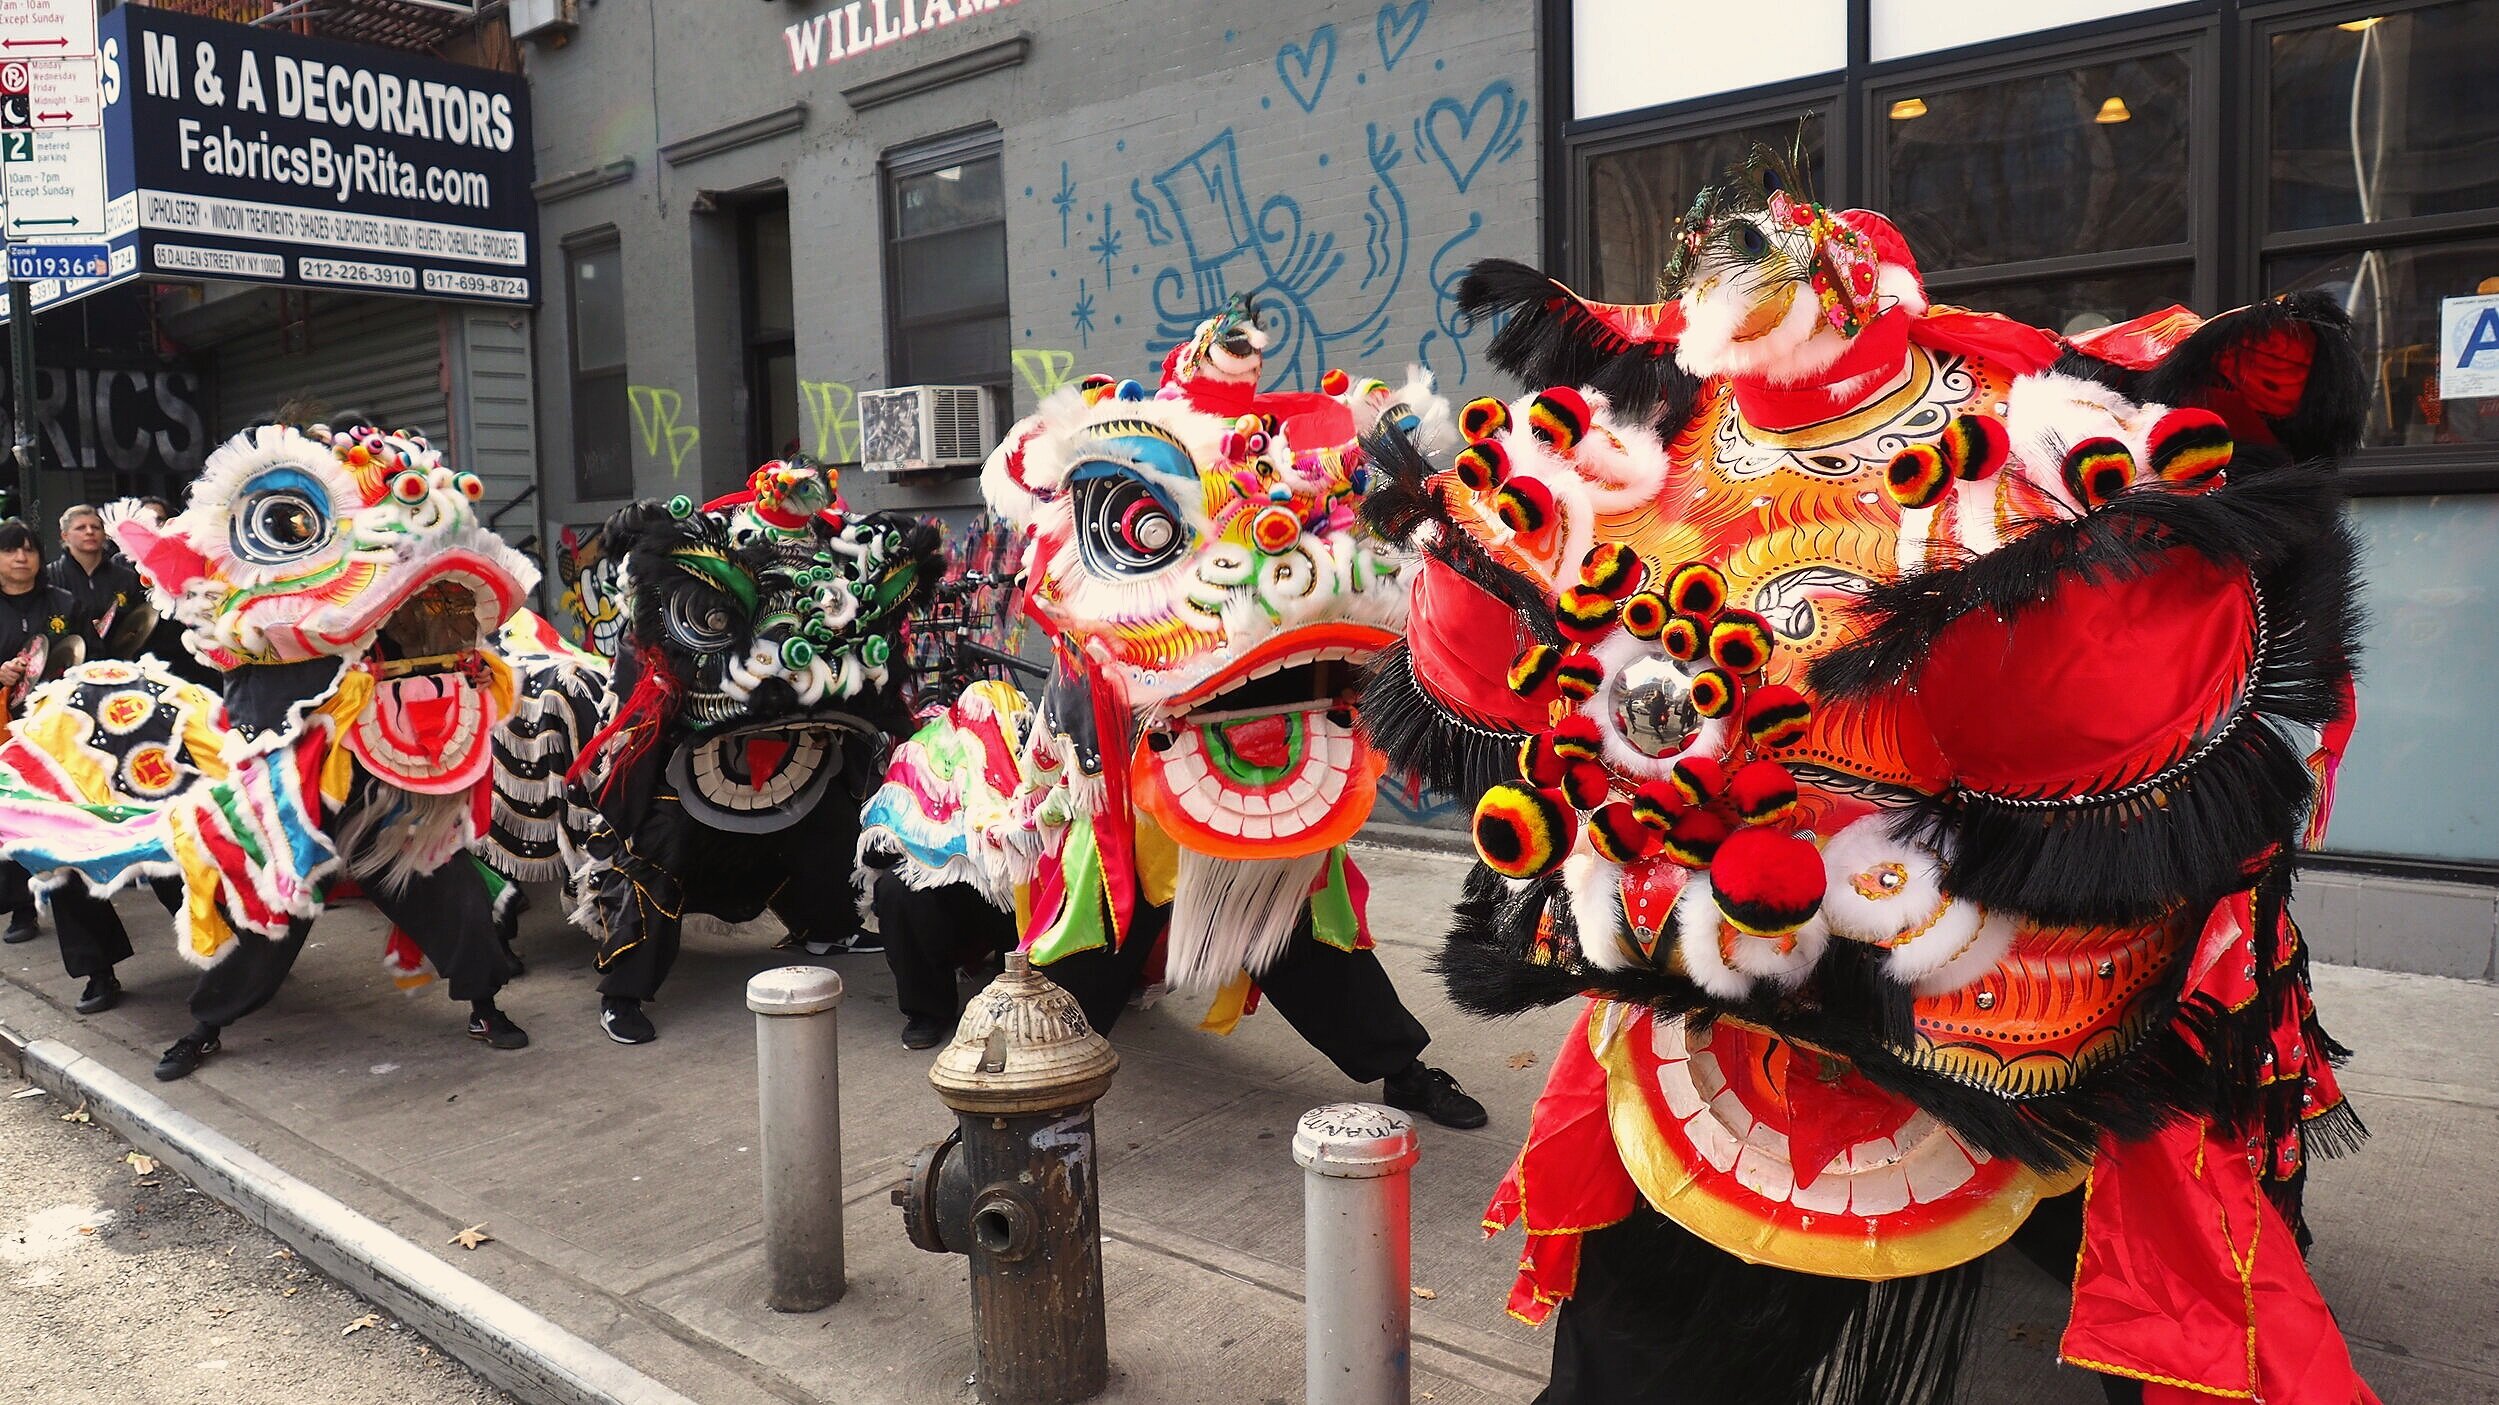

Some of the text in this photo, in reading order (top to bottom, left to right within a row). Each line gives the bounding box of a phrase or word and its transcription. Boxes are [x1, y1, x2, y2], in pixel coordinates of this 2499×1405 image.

[32, 13, 65, 25] Sunday
[784, 0, 1000, 75] WILLIA
[142, 30, 514, 153] M & A DECORATORS
[9, 132, 27, 160] 2
[178, 117, 490, 209] FabricsByRita.com
[9, 173, 32, 184] 10am
[41, 172, 60, 183] 7pm
[9, 186, 75, 198] Except Sunday
[147, 196, 200, 227] UPHOLSTERY
[209, 203, 244, 231] WINDOW
[245, 208, 294, 236] TREATMENTS
[299, 213, 329, 240] SHADES
[335, 217, 378, 244] SLIPCOVERS
[383, 222, 409, 248] BLINDS
[414, 226, 442, 251] VELVETS
[446, 231, 478, 256] CHENILLE
[482, 233, 518, 260] BROCADES
[12, 257, 85, 276] 101936
[156, 247, 166, 264] 85
[175, 250, 201, 267] ALLEN
[202, 253, 234, 271] STREET
[235, 256, 246, 271] NY
[247, 257, 258, 272] NY
[260, 258, 282, 274] 10002
[303, 261, 411, 285] 212-226-3910
[427, 272, 525, 295] 917-699-8724
[2456, 307, 2499, 369] A
